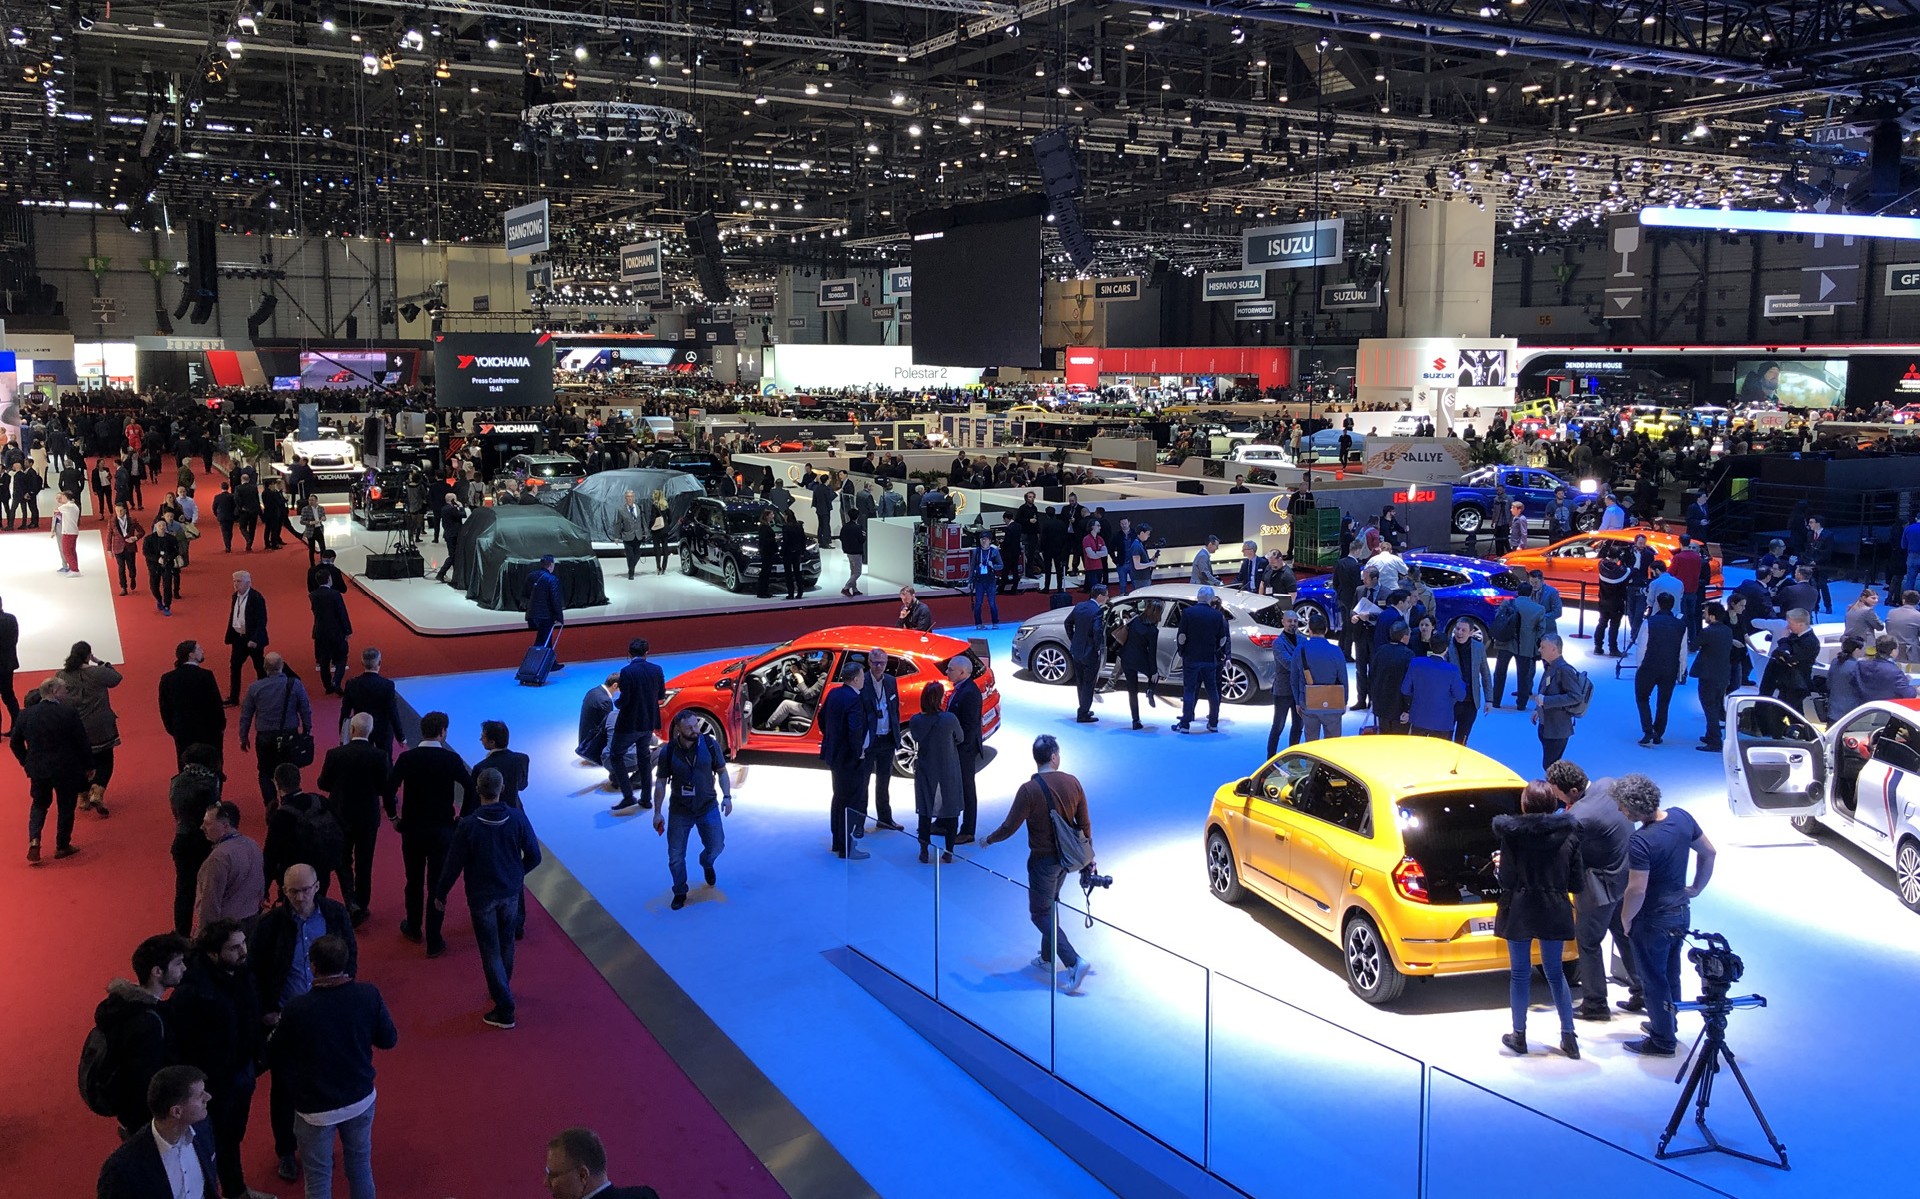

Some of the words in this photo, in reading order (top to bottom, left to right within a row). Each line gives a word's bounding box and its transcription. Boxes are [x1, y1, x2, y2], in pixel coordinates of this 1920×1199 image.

[508, 219, 543, 241] SSANGYONG
[1268, 235, 1314, 256] ISUZU
[625, 254, 655, 270] YOKOHAMA
[1208, 281, 1237, 291] HISPANO
[1238, 279, 1259, 289] SUIZA
[1901, 274, 1920, 285] GF
[1100, 285, 1112, 295] SIN
[1113, 284, 1131, 294] CARS
[1333, 291, 1367, 301] SUZUKI
[1237, 306, 1272, 314] MOTORWORLD
[1539, 315, 1551, 325] 55
[166, 338, 226, 350] Ferrari
[475, 356, 530, 368] YOKOHAMA
[1585, 361, 1602, 369] DRIVE
[1602, 361, 1623, 369] HOUSE
[894, 366, 938, 379] Polestar
[940, 367, 948, 379] 2
[493, 424, 539, 433] YOKOHAMA
[1383, 452, 1395, 462] LE
[1400, 452, 1443, 462] RALLYE
[1478, 921, 1495, 931] RE
